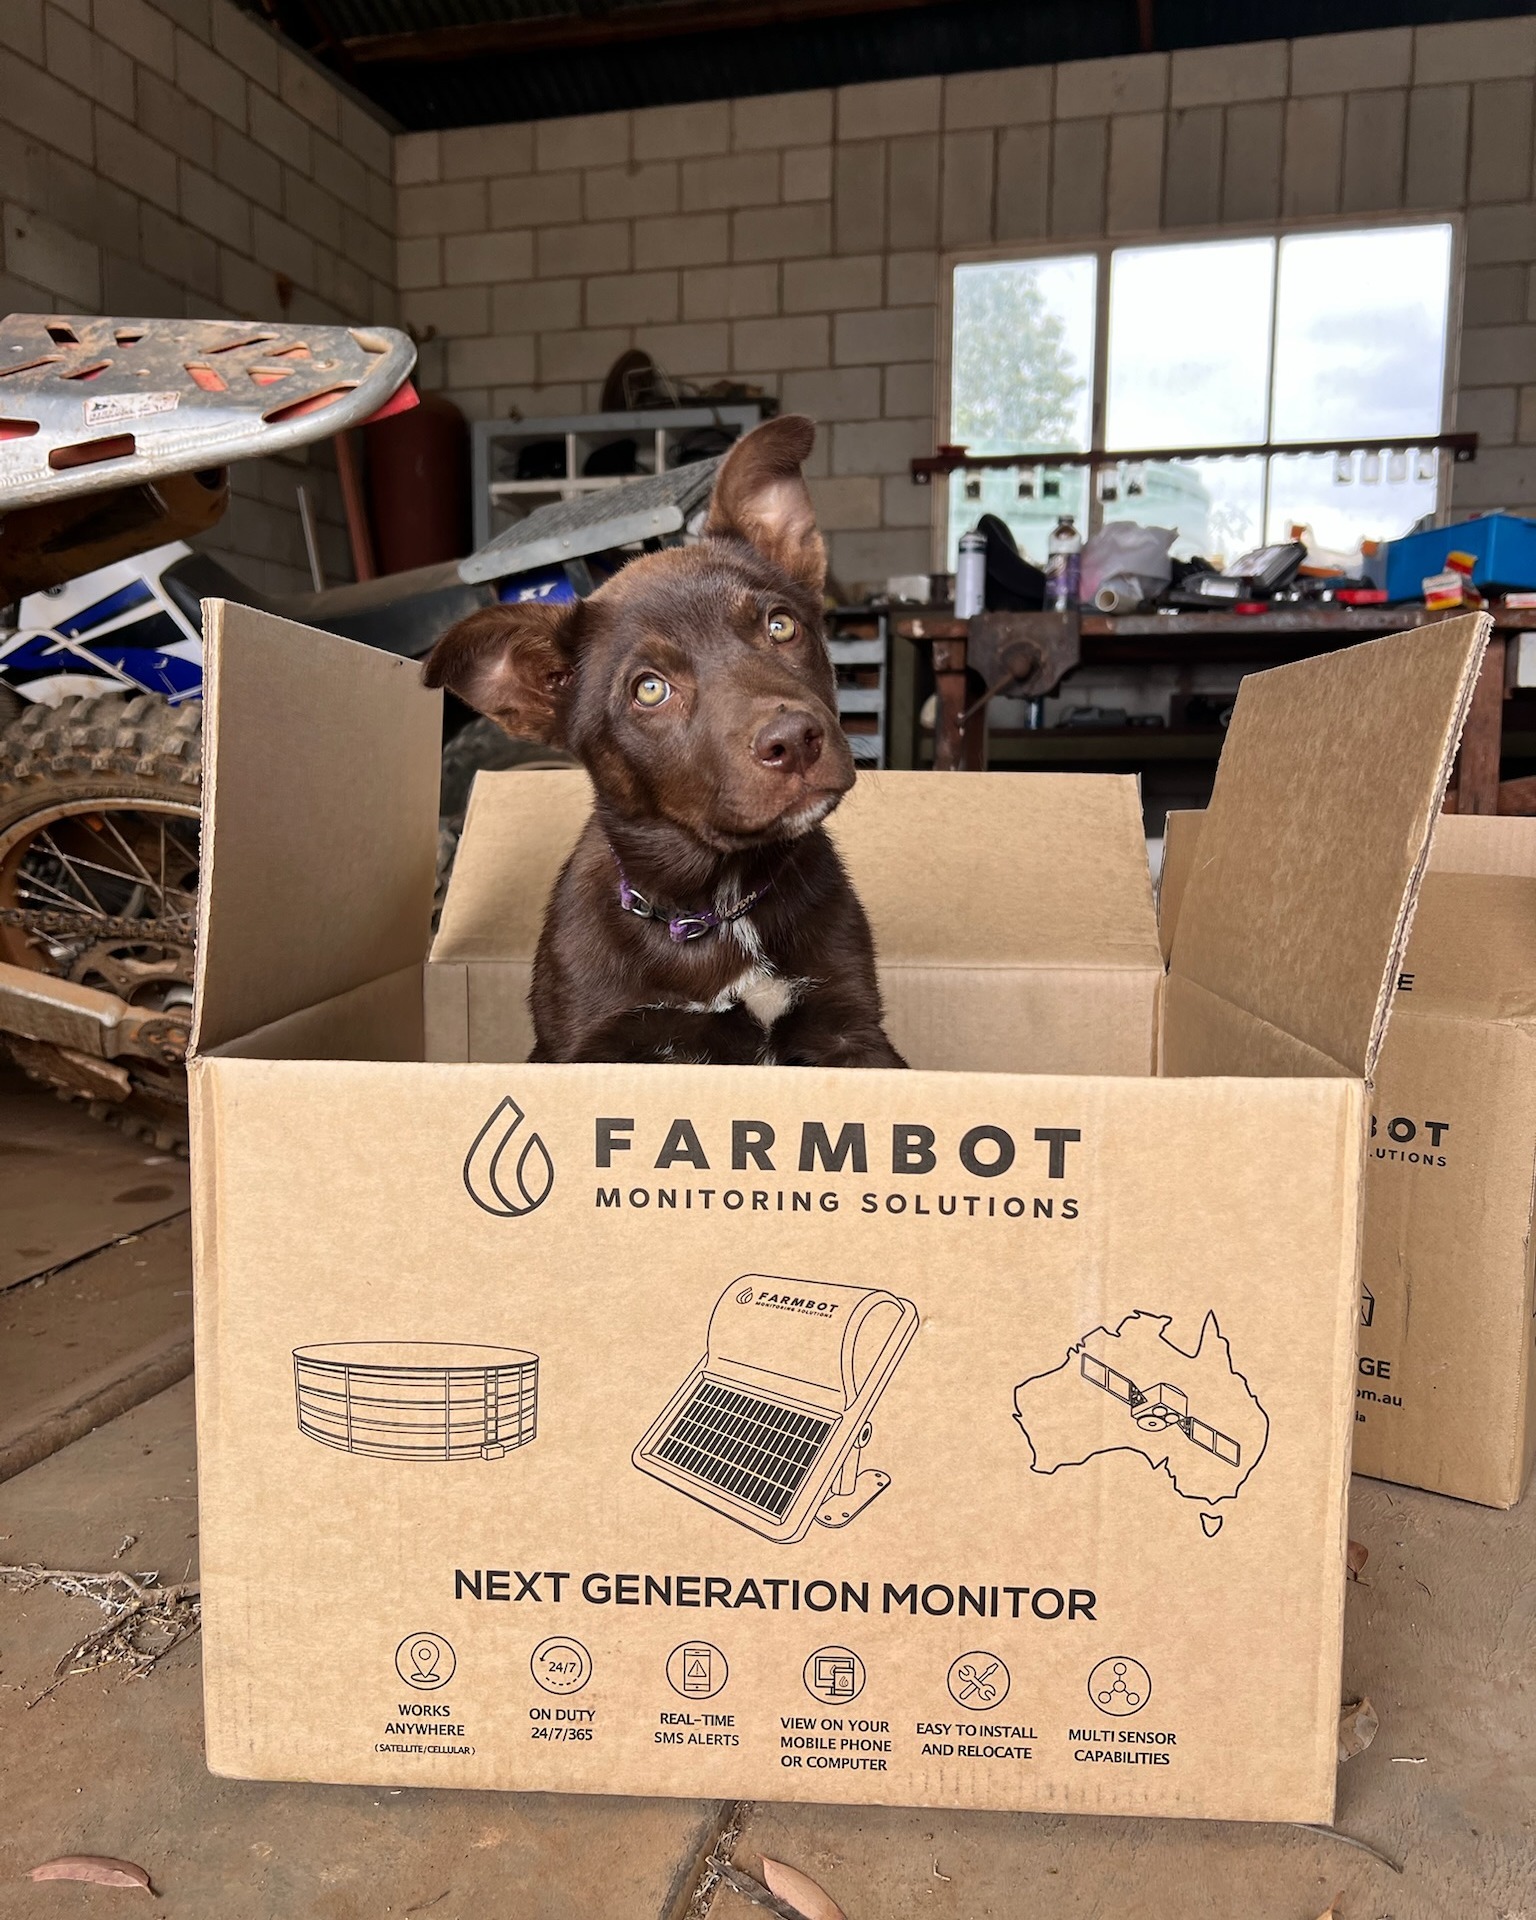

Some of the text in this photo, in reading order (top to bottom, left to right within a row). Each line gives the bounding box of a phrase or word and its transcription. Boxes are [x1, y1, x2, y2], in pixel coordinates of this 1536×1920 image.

[596, 1118, 1081, 1178] FARMBOT
[1370, 1148, 1446, 1166] UTIONS
[596, 1188, 1078, 1219] MONITORING SOLUTIONS
[758, 1292, 838, 1313] FARMBOT
[455, 1570, 1097, 1620] NEXT GENERATION MONITOR
[549, 1662, 576, 1674] 24/7
[398, 1704, 450, 1716] WORKS
[530, 1708, 595, 1721] ON DUTY
[661, 1713, 734, 1726] REAL-TIME
[781, 1718, 889, 1732] VIEW ON YOUR
[385, 1723, 464, 1736] ANYWHERE
[532, 1727, 592, 1741] 24/7/365
[917, 1723, 1038, 1738] EASY TO INSTALL
[655, 1732, 739, 1746] SMS ALERTS
[781, 1737, 891, 1751] MOBILE PHONE
[1069, 1729, 1176, 1745] MULTI SENSOR
[922, 1744, 1032, 1759] AND RELOCATE
[1075, 1750, 1169, 1764] CAPABILITIES
[781, 1756, 887, 1770] OR COMPUTER
